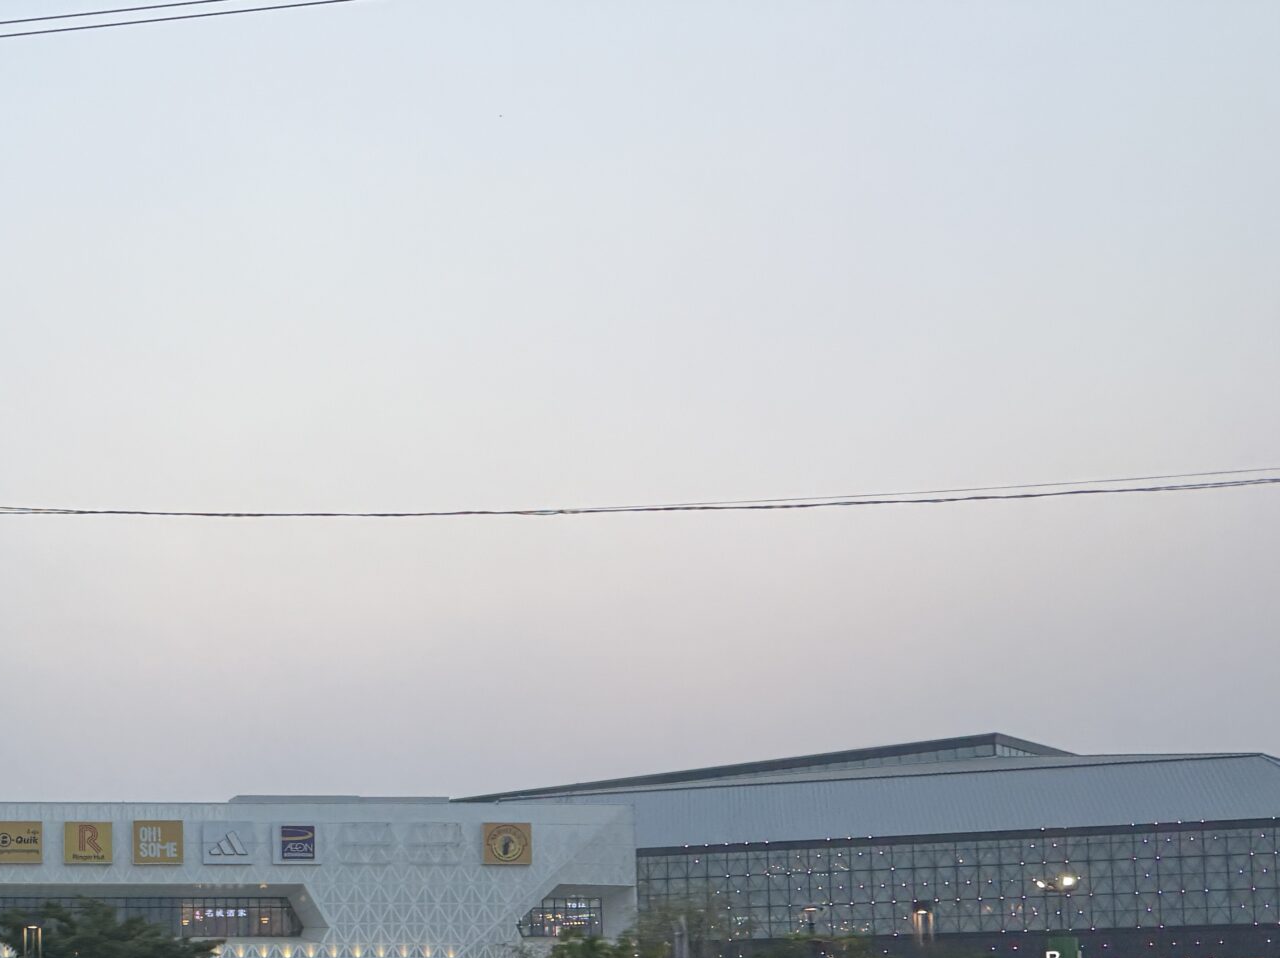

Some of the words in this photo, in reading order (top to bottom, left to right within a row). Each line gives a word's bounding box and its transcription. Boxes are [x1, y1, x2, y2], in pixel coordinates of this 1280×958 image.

[140, 827, 161, 842] OH!
[140, 842, 177, 858] SOME
[284, 843, 313, 852] AEON
